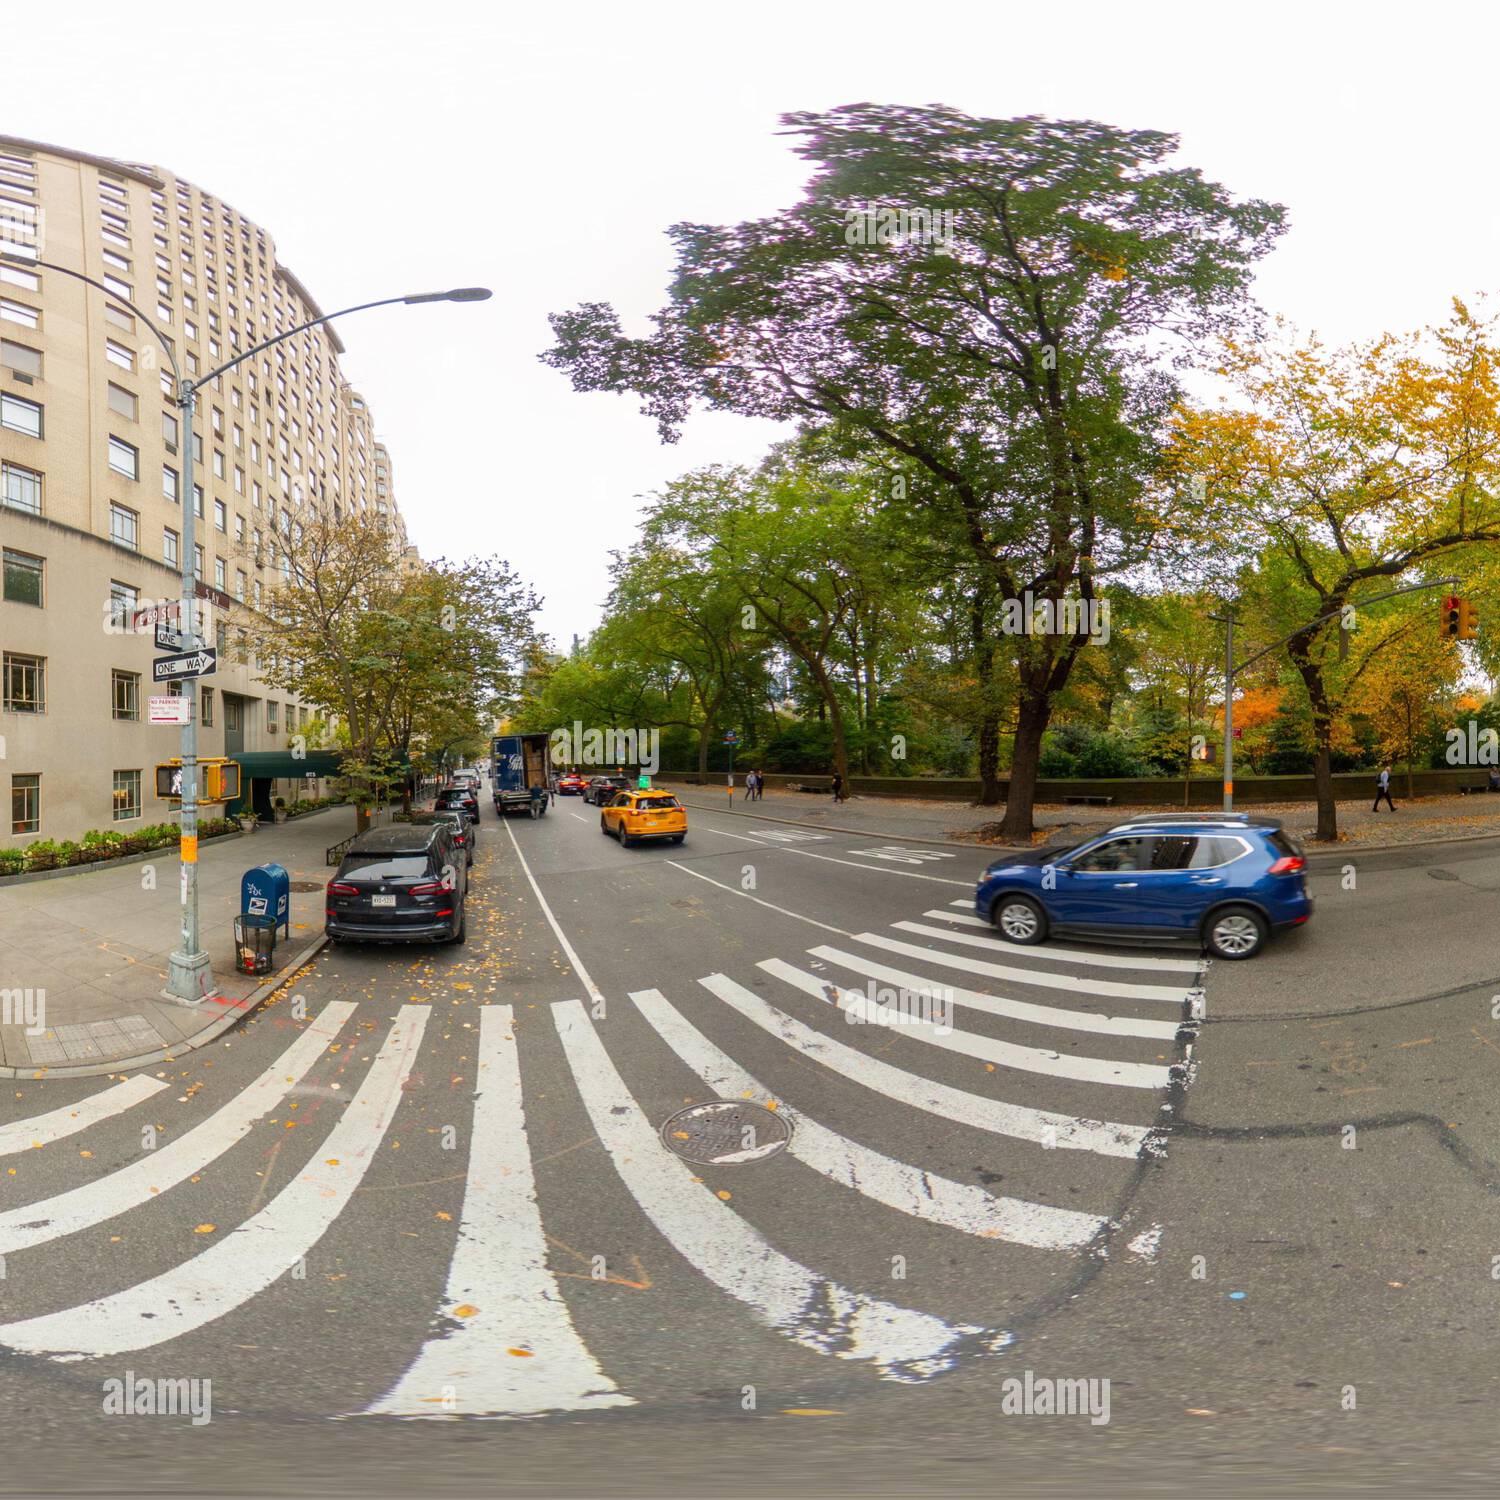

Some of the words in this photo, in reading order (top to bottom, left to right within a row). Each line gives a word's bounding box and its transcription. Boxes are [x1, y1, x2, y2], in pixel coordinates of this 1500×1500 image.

[147, 610, 158, 622] 69
[159, 631, 176, 645] ONE
[158, 662, 176, 674] ONE
[186, 656, 207, 670] WAY
